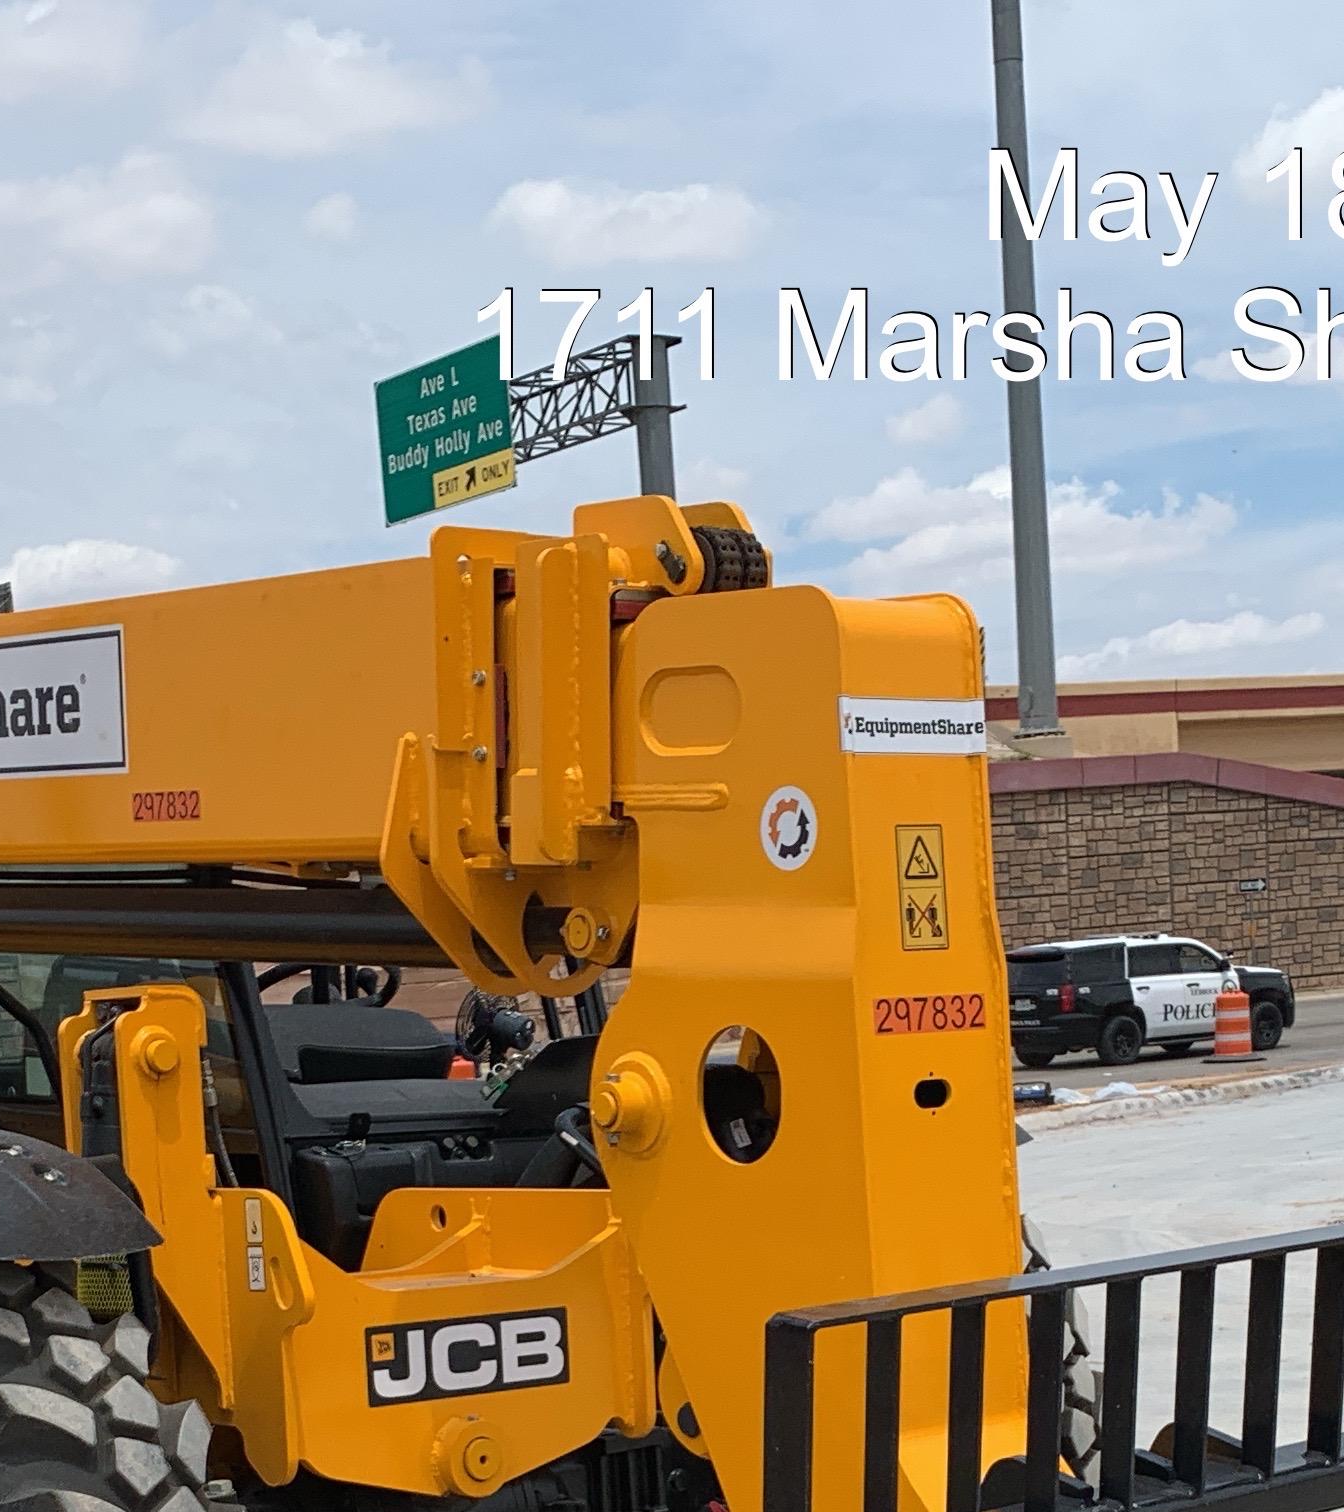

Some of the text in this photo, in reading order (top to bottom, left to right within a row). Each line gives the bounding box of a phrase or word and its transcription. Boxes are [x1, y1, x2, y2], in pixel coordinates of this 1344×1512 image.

[420, 366, 459, 398] Ave L
[407, 395, 477, 435] Texas Ave
[388, 419, 503, 475] Buddy Holly Ave
[438, 459, 510, 497] EXIT ONLY
[855, 716, 984, 738] EquipmentShare
[133, 790, 200, 821] 297832
[876, 994, 985, 1033] 297832
[373, 1315, 565, 1398] JCB
